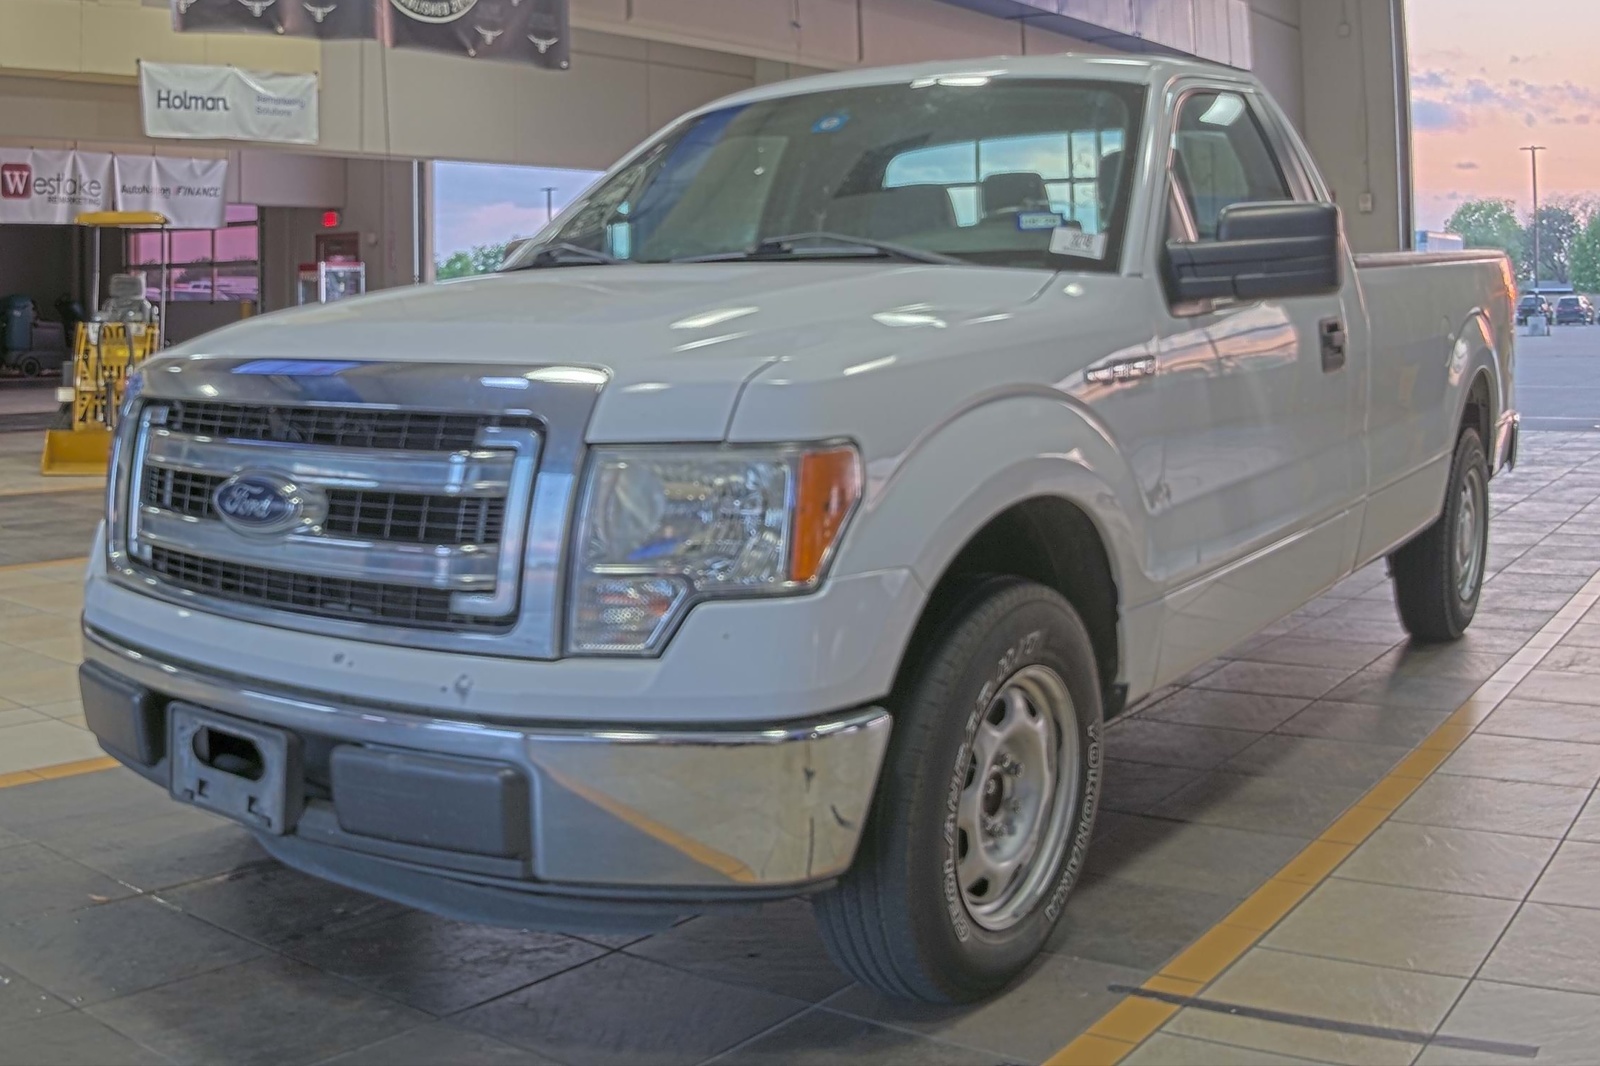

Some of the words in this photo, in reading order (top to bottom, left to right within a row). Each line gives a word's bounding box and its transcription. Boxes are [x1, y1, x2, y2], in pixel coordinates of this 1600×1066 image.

[157, 89, 230, 111] Holman
[2, 163, 101, 199] Westlake
[224, 483, 274, 519] Ford
[1044, 719, 1100, 921] YOKOHAMA
